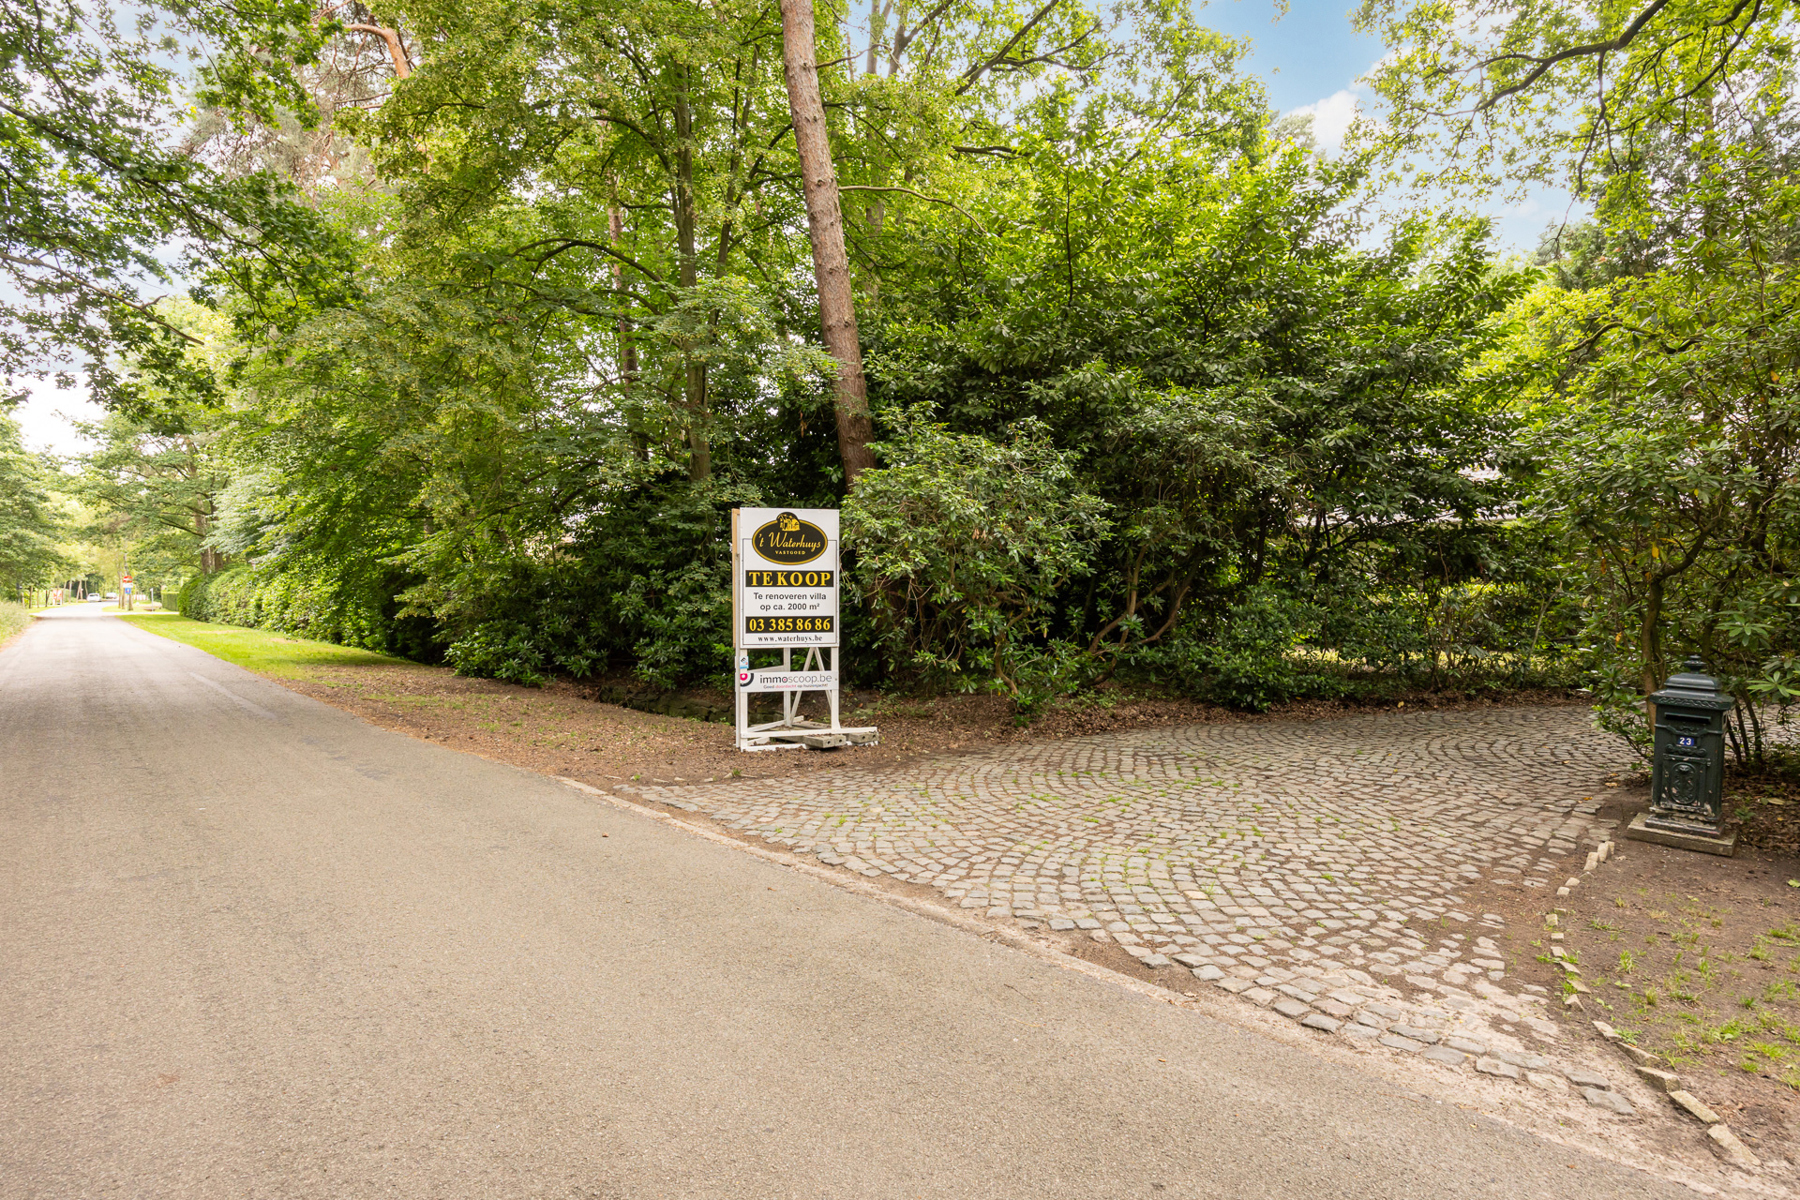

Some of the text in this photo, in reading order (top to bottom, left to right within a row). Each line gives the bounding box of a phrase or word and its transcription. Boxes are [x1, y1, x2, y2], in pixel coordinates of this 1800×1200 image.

[768, 531, 821, 552] Waterhuys
[753, 592, 763, 600] Te
[809, 592, 827, 600] villa
[760, 604, 771, 612] op
[749, 618, 765, 632] 03
[768, 618, 793, 631] 385
[758, 635, 823, 643] www.waterhuys.be
[760, 674, 832, 684] immoscoop.be
[1679, 736, 1692, 746] 23
